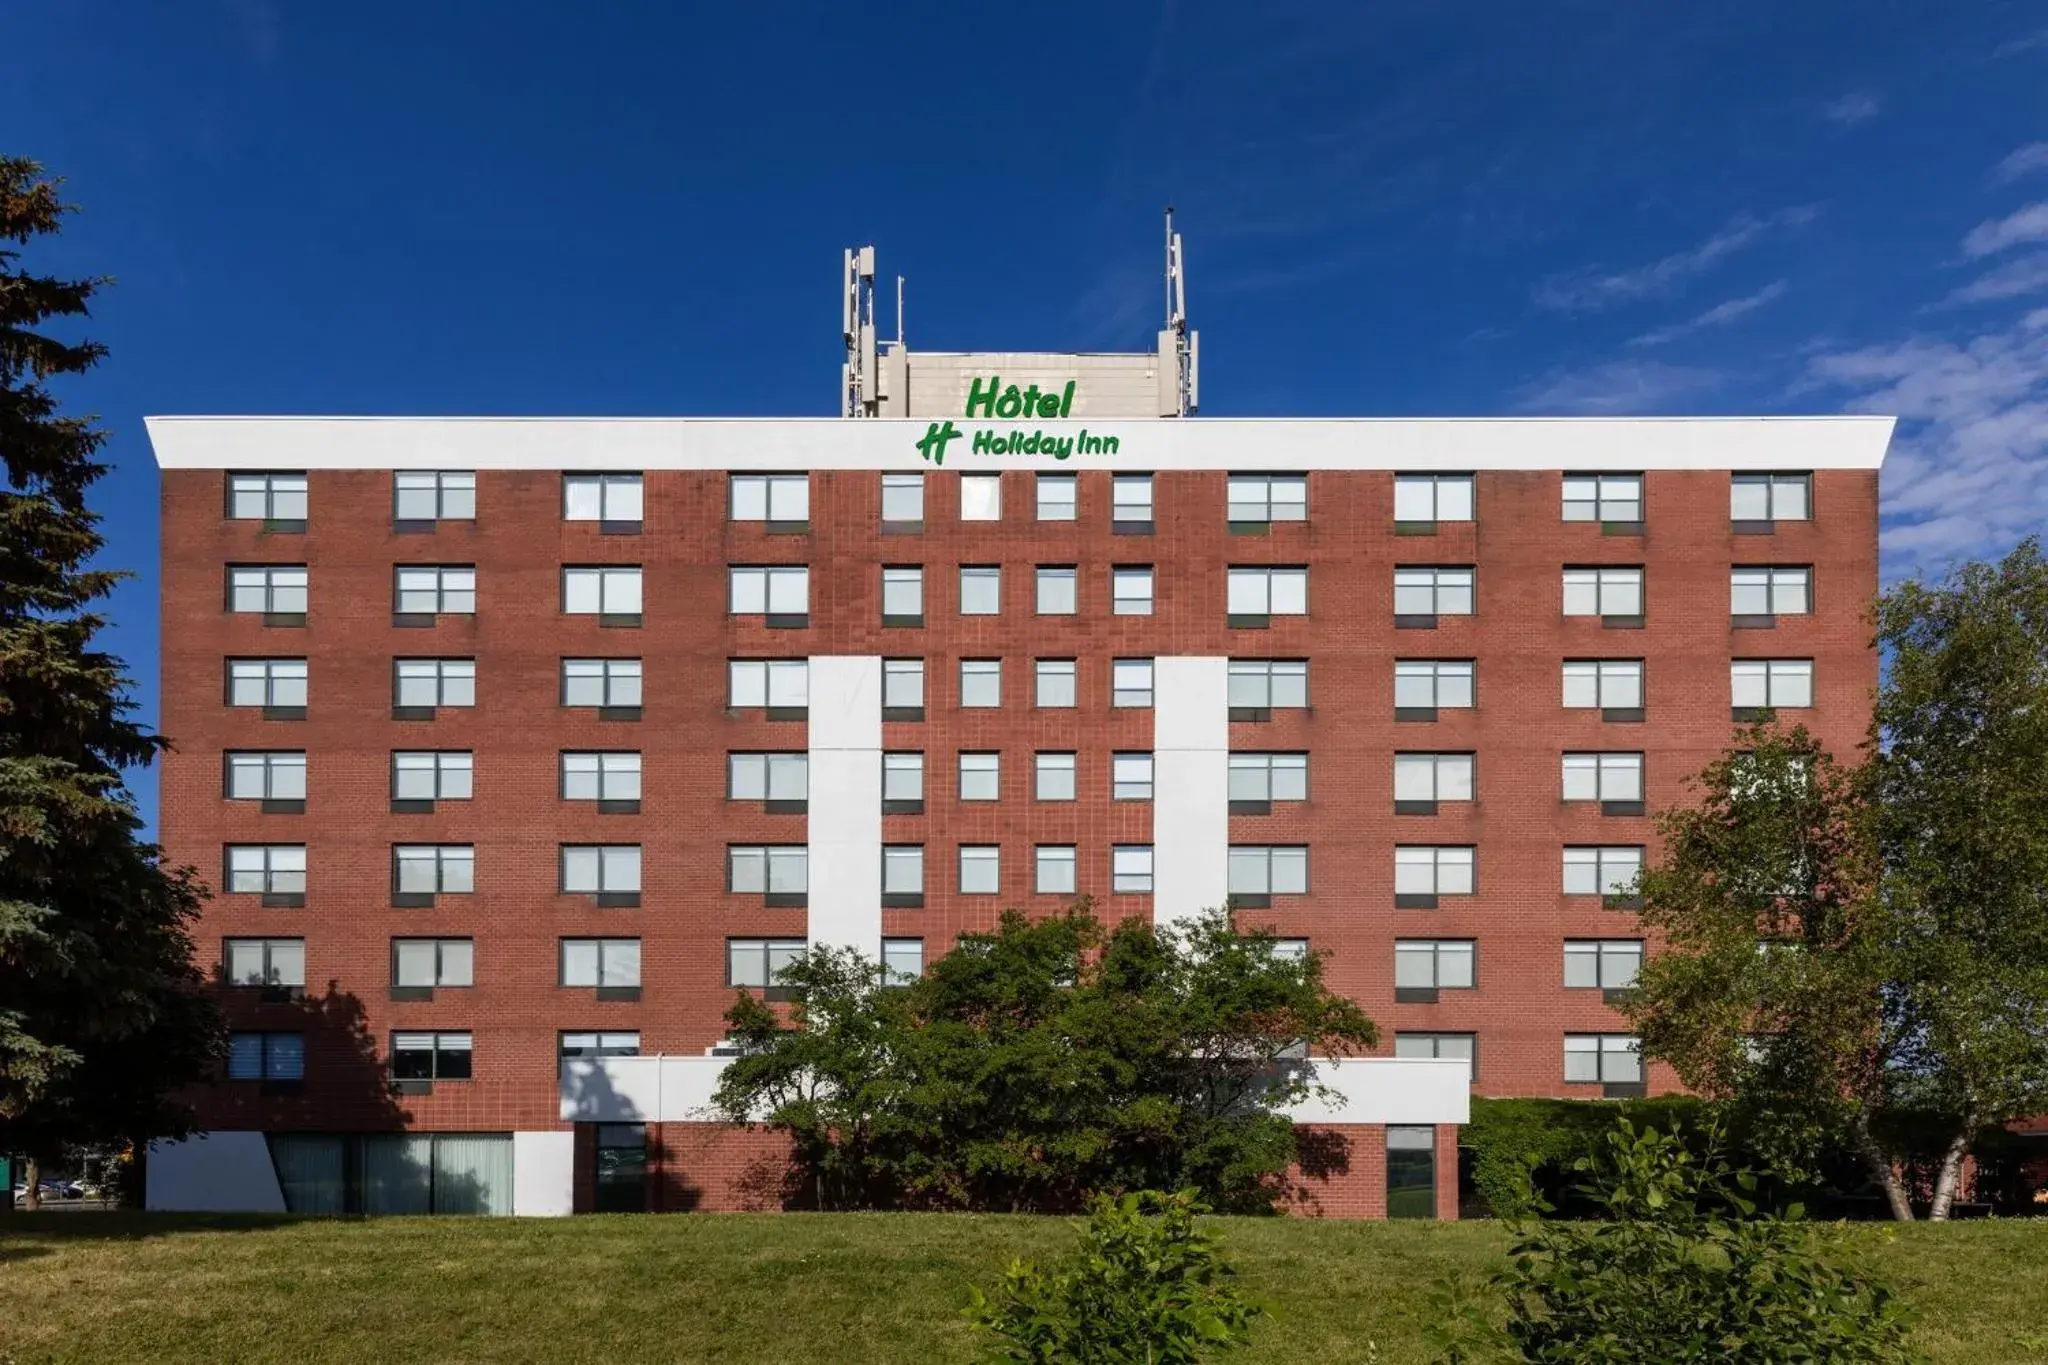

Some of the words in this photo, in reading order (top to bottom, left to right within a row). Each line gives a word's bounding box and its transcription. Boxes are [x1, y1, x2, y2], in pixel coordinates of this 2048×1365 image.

[965, 376, 1076, 418] Hôtel
[972, 430, 1073, 459] Holiday
[1078, 430, 1119, 454] Inn
